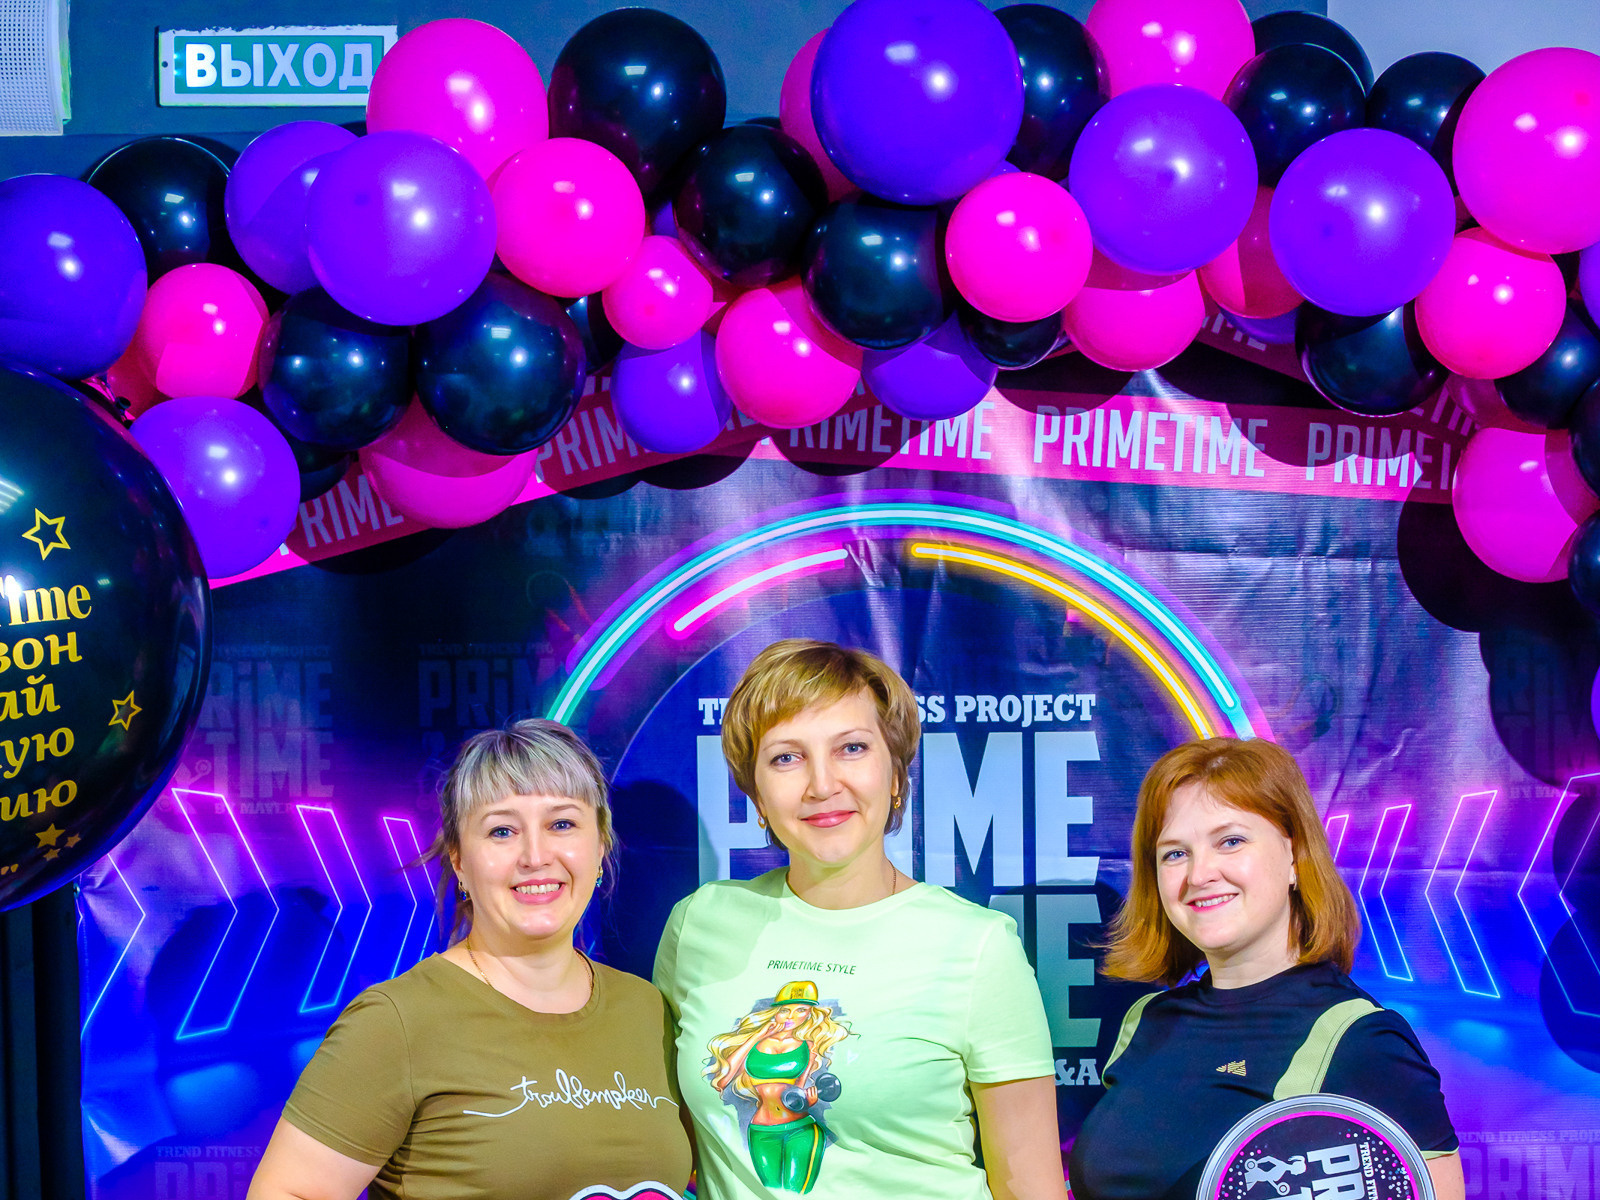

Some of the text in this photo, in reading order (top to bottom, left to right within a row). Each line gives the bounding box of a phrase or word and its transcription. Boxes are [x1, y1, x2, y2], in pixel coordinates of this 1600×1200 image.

[185, 42, 374, 91] ВЫХОД
[1034, 405, 1268, 478] PRIMETIME
[955, 693, 1096, 728] PROJECT
[766, 959, 857, 975] PRIMETIME STYLE
[1055, 1059, 1100, 1086] &A
